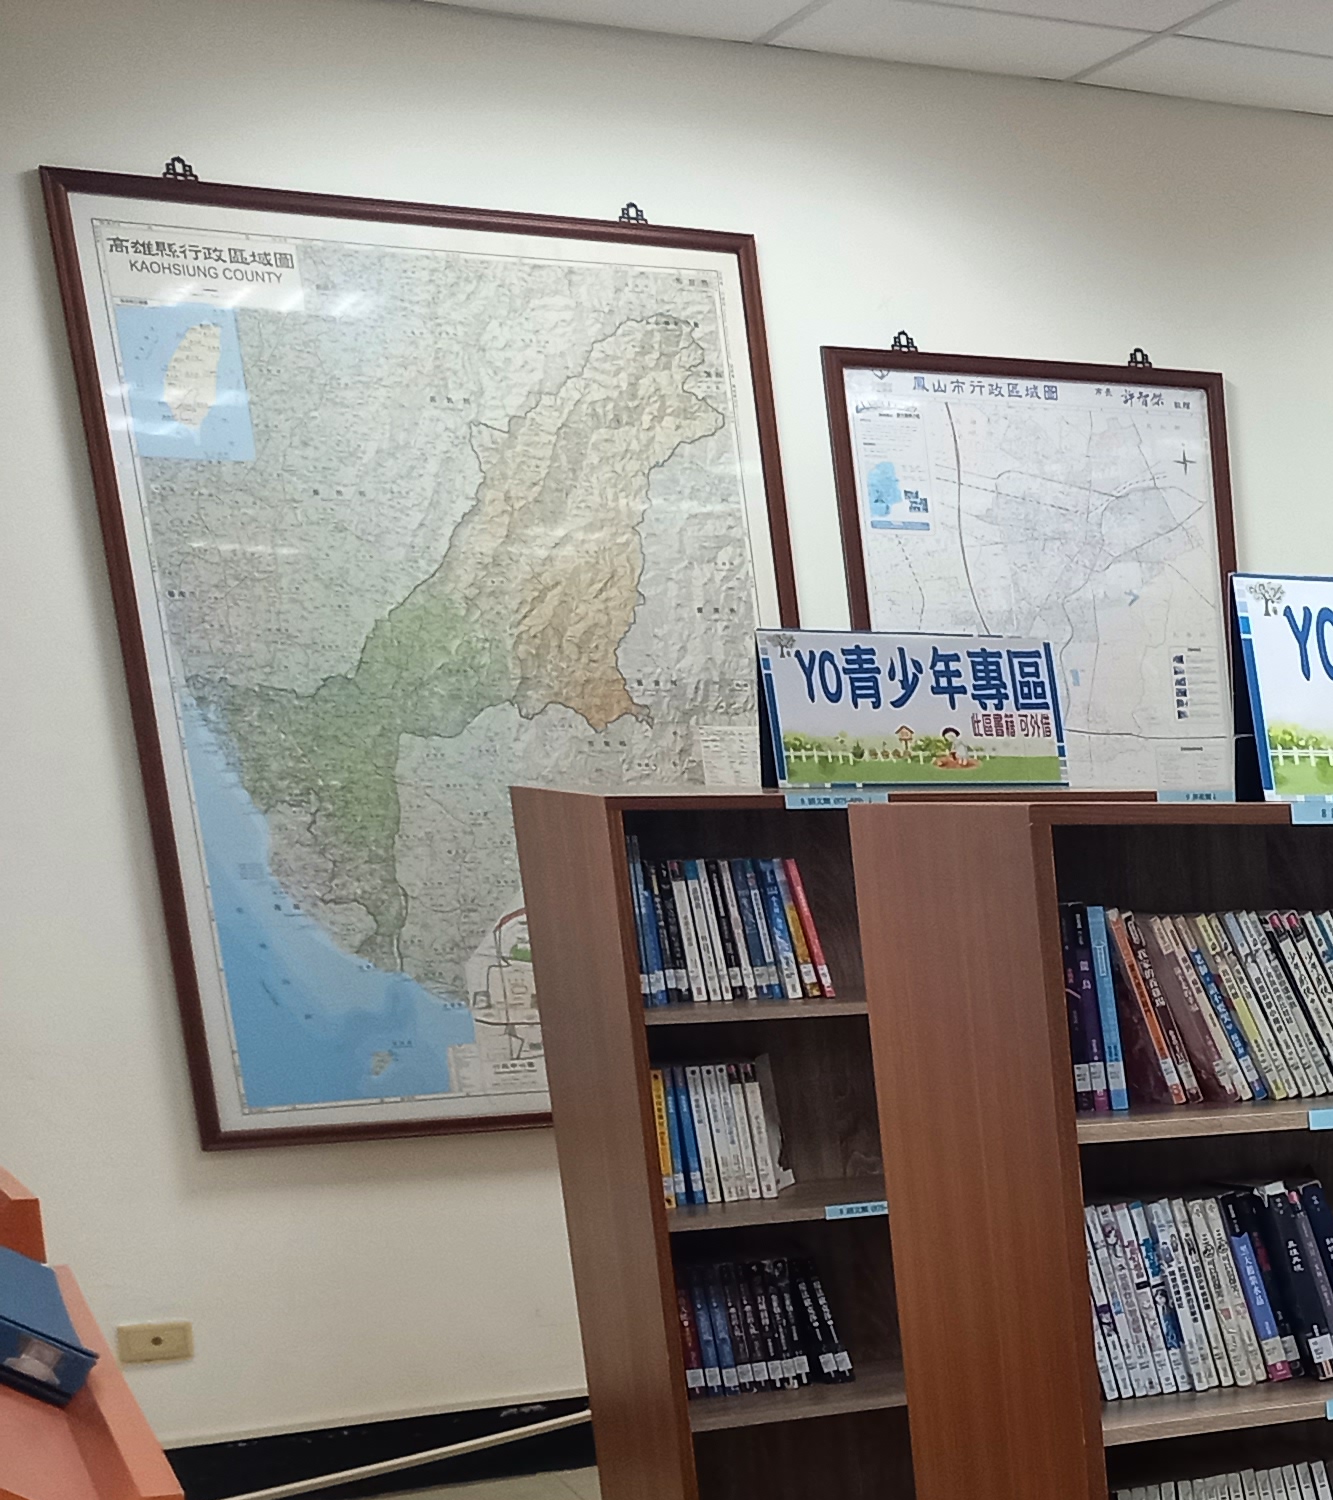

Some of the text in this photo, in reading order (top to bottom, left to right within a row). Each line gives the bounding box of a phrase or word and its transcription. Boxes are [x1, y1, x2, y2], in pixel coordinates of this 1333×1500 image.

[106, 237, 294, 269] 高雄縣行政區域圖
[129, 259, 282, 283] KAOHSIUNG COUNTY
[912, 376, 1058, 401] 鳳山市行政區域圖
[793, 644, 1051, 712] YO青少年專區
[971, 712, 1052, 739] 此區書籍 可外借
